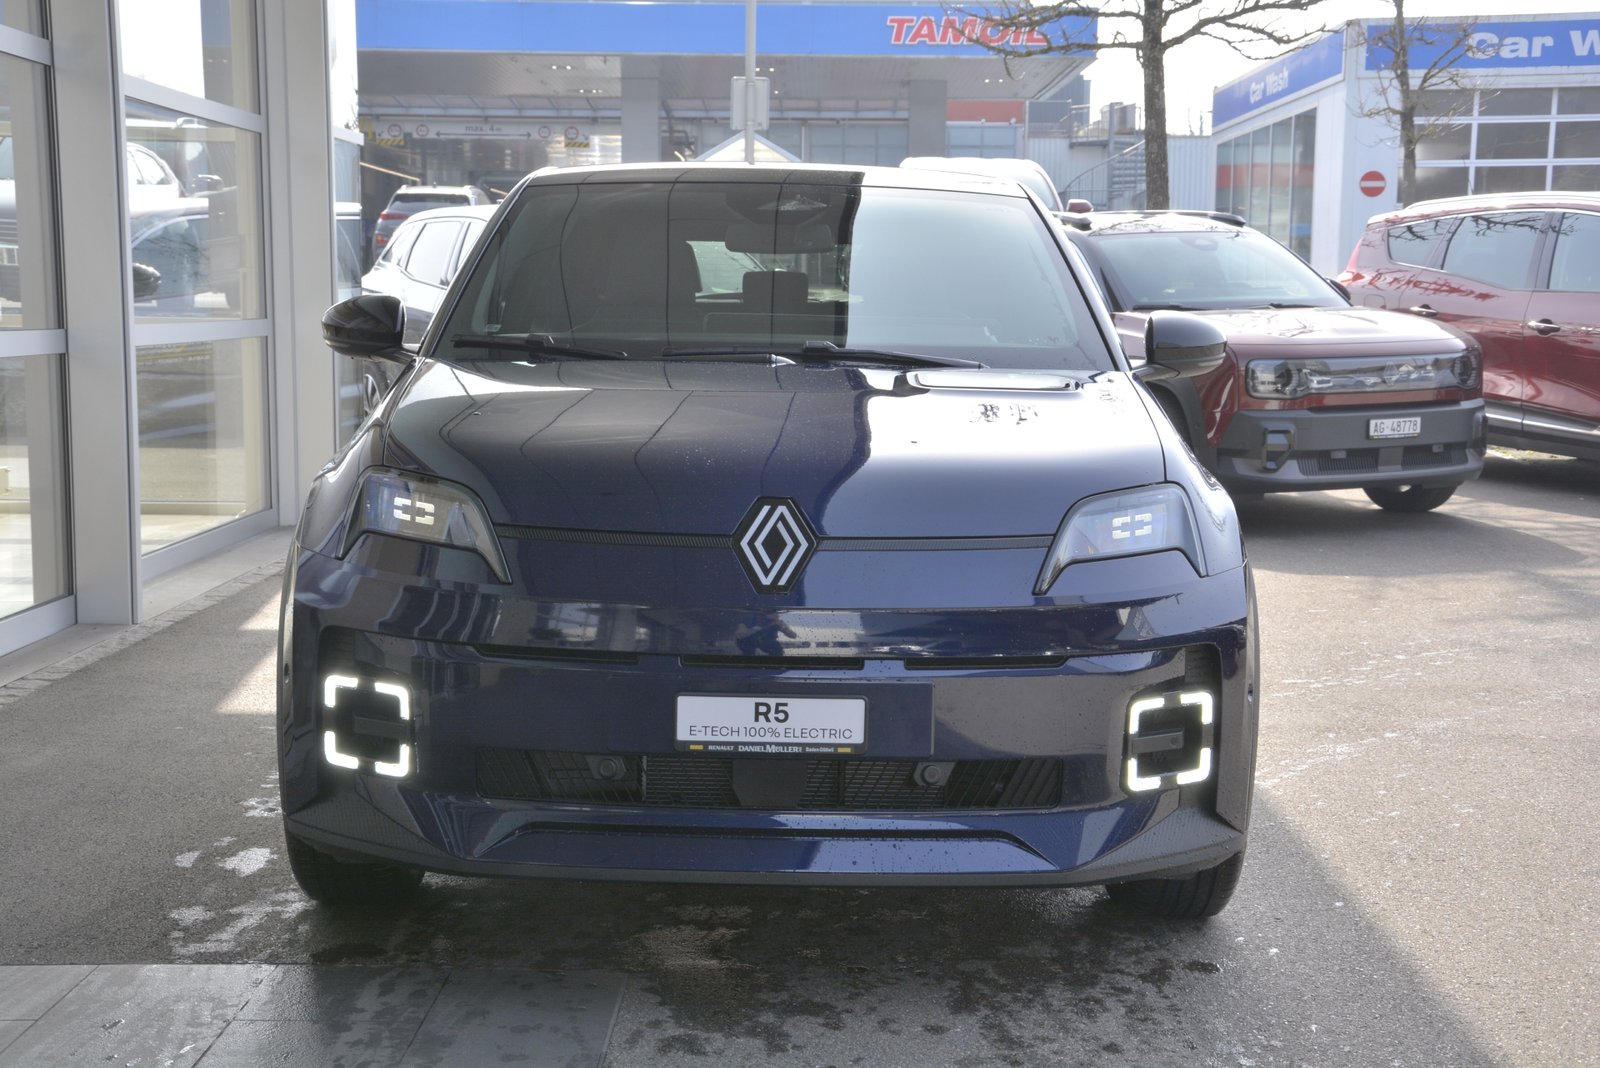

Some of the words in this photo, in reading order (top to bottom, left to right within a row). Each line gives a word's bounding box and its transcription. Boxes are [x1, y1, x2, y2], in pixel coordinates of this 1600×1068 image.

[888, 15, 1050, 46] TAMOIL
[1466, 32, 1554, 59] Car
[1249, 82, 1265, 104] Car
[1265, 66, 1289, 97] Wash
[753, 701, 789, 724] R5
[689, 725, 740, 738] E-TECH
[743, 726, 781, 739] 100%
[783, 727, 853, 740] ELECTRIC
[708, 744, 734, 752] RENAULT
